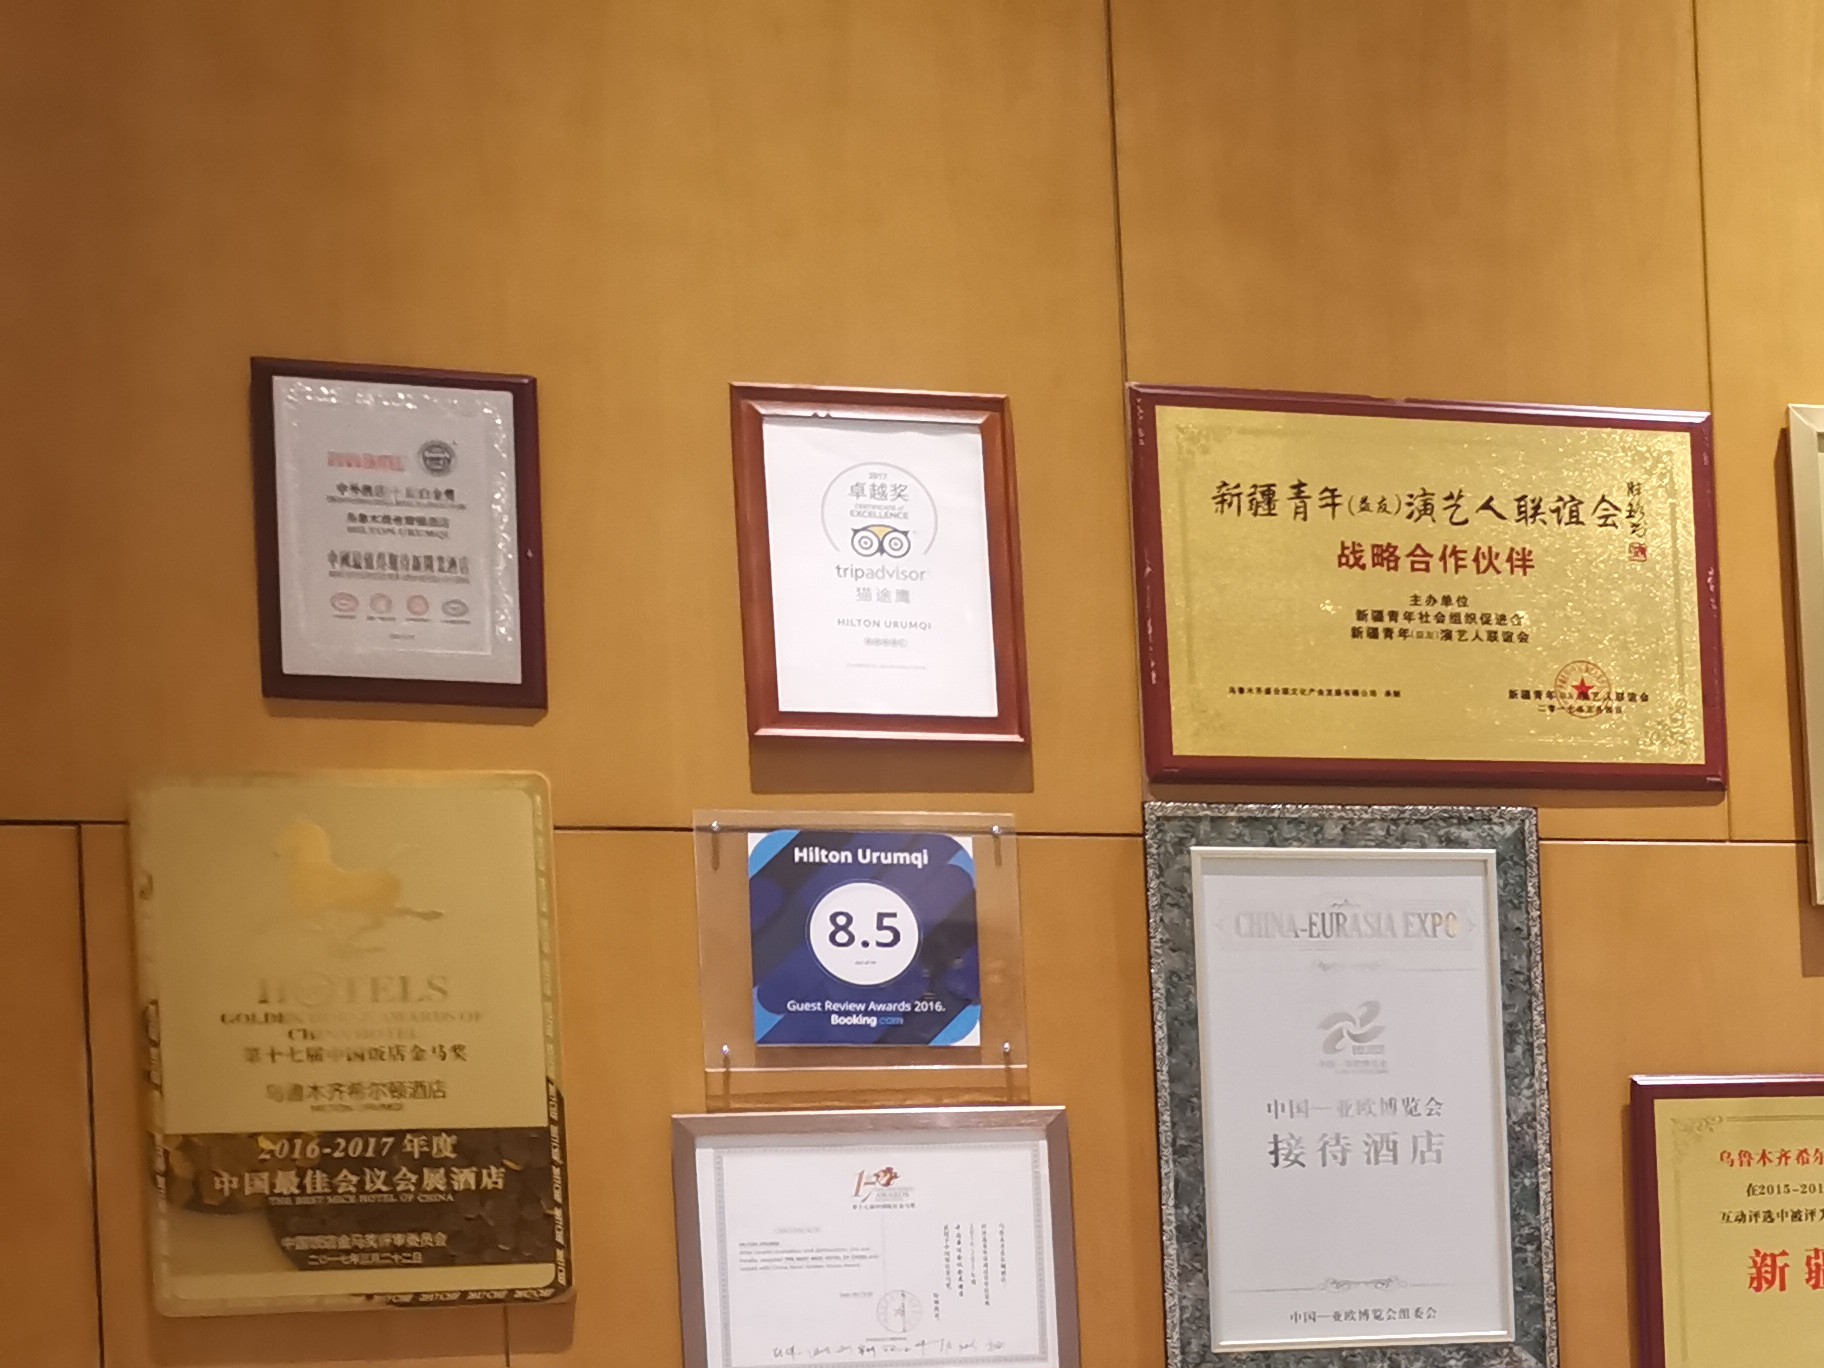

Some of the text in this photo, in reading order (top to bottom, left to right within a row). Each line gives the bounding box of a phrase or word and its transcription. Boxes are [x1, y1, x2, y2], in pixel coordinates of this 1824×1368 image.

[848, 482, 910, 502] 卓越奖
[849, 510, 910, 521] EXCELLENCE
[1337, 540, 1535, 577] 战略合作伙伴
[835, 563, 927, 582] tripadvisor
[855, 587, 911, 605] 猫途鹰
[1409, 594, 1470, 608] 主办单位
[837, 618, 932, 631] HILTON URUMQI
[1356, 609, 1526, 627] 新疆青年社会组织促进会
[794, 847, 929, 869] Hilton Urumqi
[828, 911, 901, 949] 8.5
[1234, 911, 1460, 940] CHINA-EURASIA EXPO
[786, 1001, 822, 1012] Guest
[824, 1000, 866, 1012] Review
[868, 1000, 912, 1012] Awards
[244, 1043, 467, 1063] 第十七届中国饭店金马奖
[265, 1080, 447, 1103] 乌鲁木齐希尔顿酒店
[257, 1132, 458, 1160] 2016-2017 年度
[1268, 1130, 1446, 1169] 接待酒店
[213, 1165, 507, 1197] 中国最佳会议会展酒店
